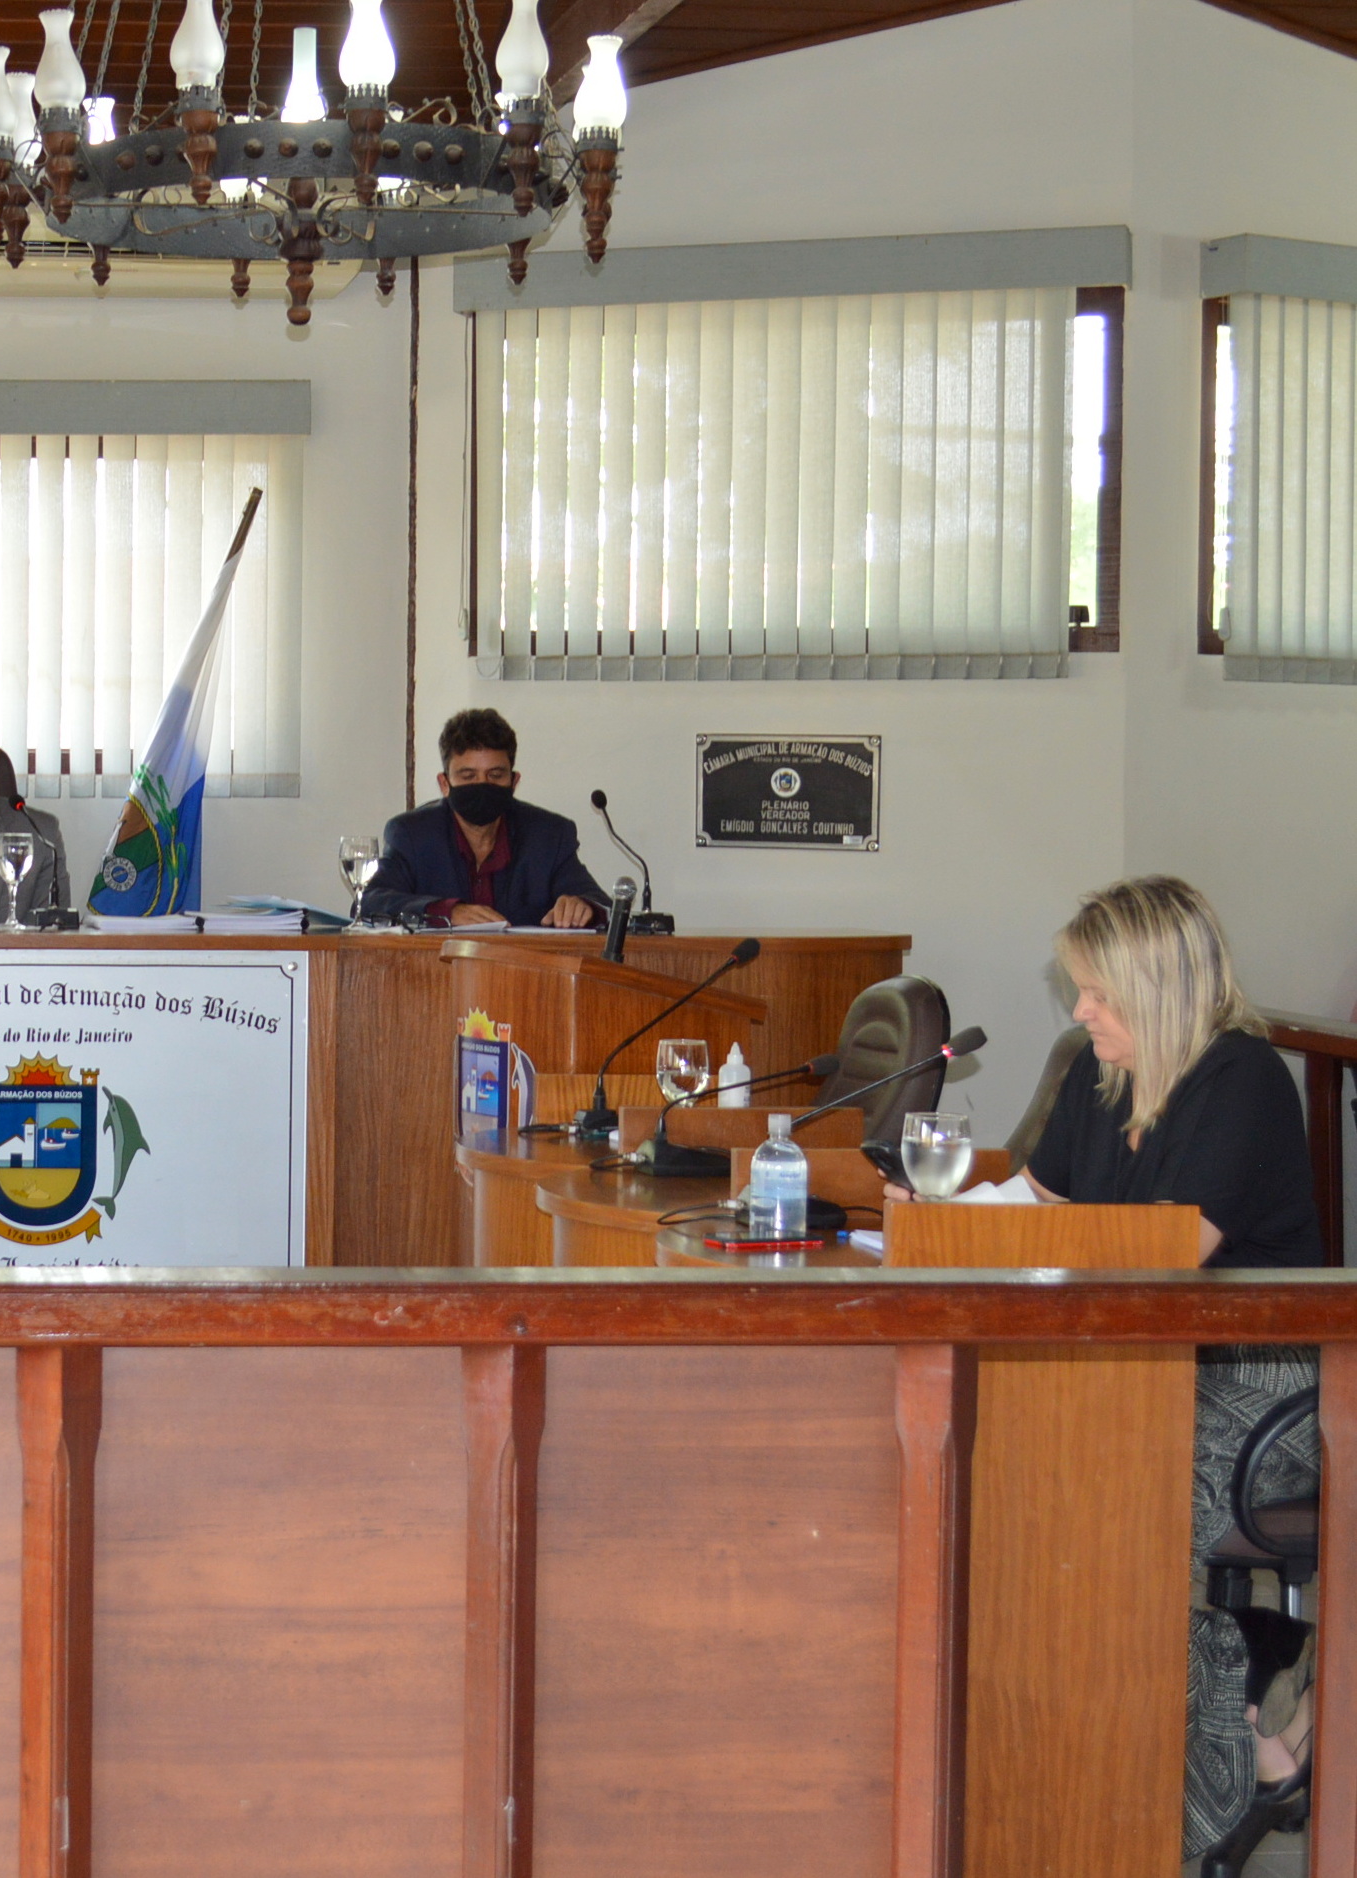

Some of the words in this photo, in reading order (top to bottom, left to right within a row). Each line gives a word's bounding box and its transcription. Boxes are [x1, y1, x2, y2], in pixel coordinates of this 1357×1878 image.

[735, 742, 778, 761] MUNICIPAL
[778, 742, 790, 755] DE
[828, 748, 846, 764] DOS
[844, 754, 873, 777] BÚZIOS
[761, 800, 810, 811] PLENÁRIO
[760, 811, 811, 820] VEREADOR
[720, 819, 755, 833] EMÍGDIO
[813, 822, 855, 836] COUTINHO
[19, 984, 43, 1006] de
[47, 982, 146, 1016] Armação
[154, 991, 195, 1016] dos
[199, 994, 282, 1034] Búzios
[3, 1028, 21, 1043] do
[25, 1028, 51, 1043] Rio
[52, 1028, 71, 1043] de
[74, 1027, 133, 1045] Janeiro
[35, 1090, 53, 1099] DOS
[54, 1089, 83, 1099] BÚZIOS
[5, 1228, 33, 1243] 1740
[45, 1228, 73, 1243] 1995
